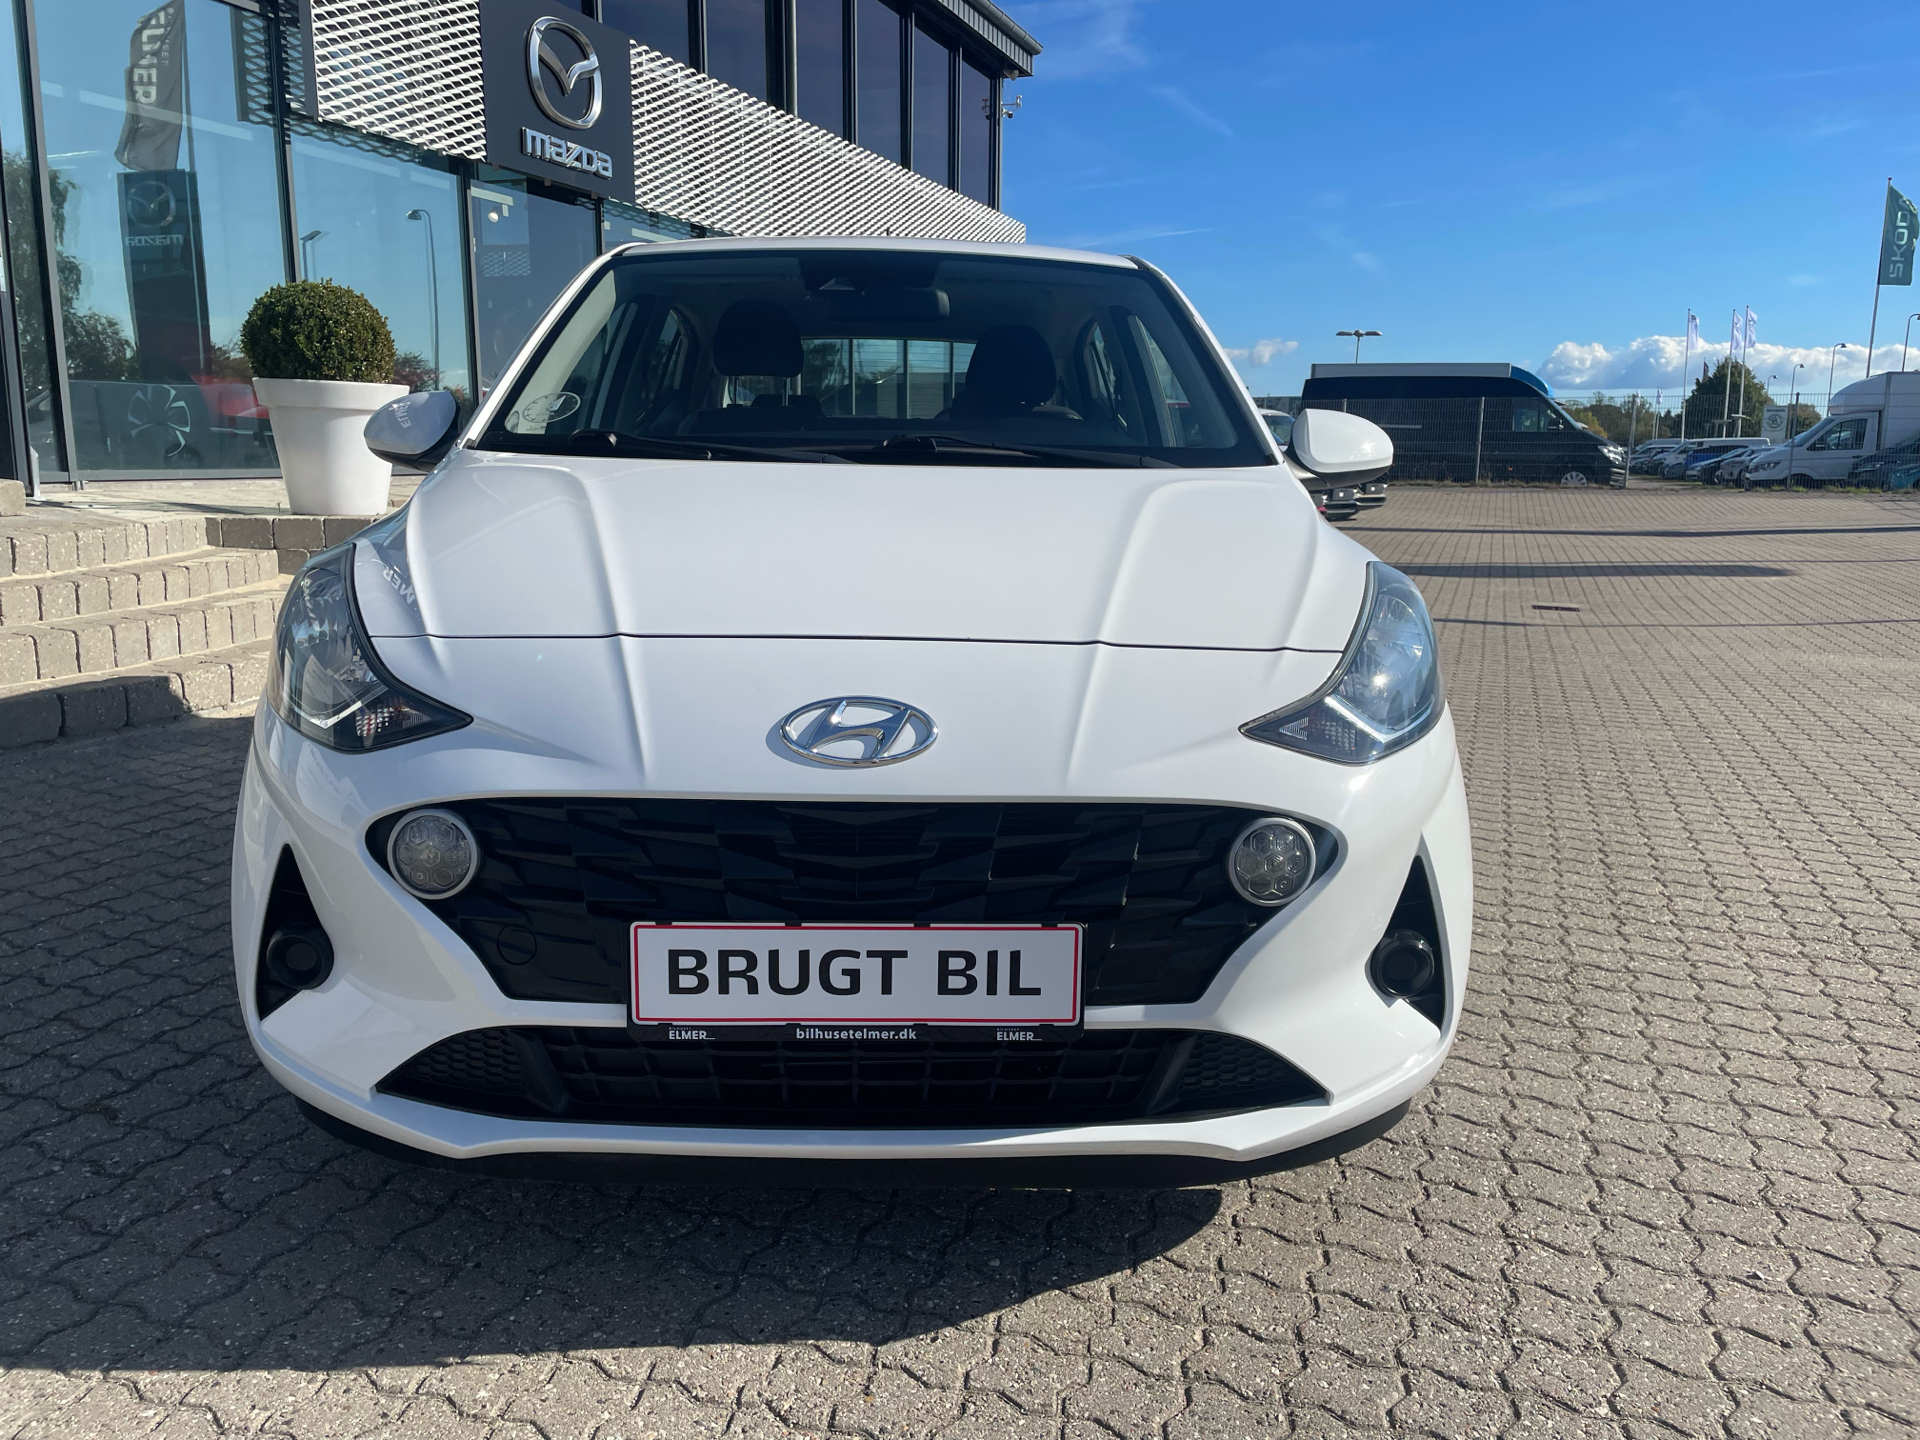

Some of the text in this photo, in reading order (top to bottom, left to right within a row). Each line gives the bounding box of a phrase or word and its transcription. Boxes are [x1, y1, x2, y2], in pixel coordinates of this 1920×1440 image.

[668, 948, 1042, 995] BRUGT BIL
[669, 1030, 715, 1040] ELMER
[796, 1028, 917, 1040] bilhusetelmer.dk
[996, 1031, 1042, 1041] ELMER
